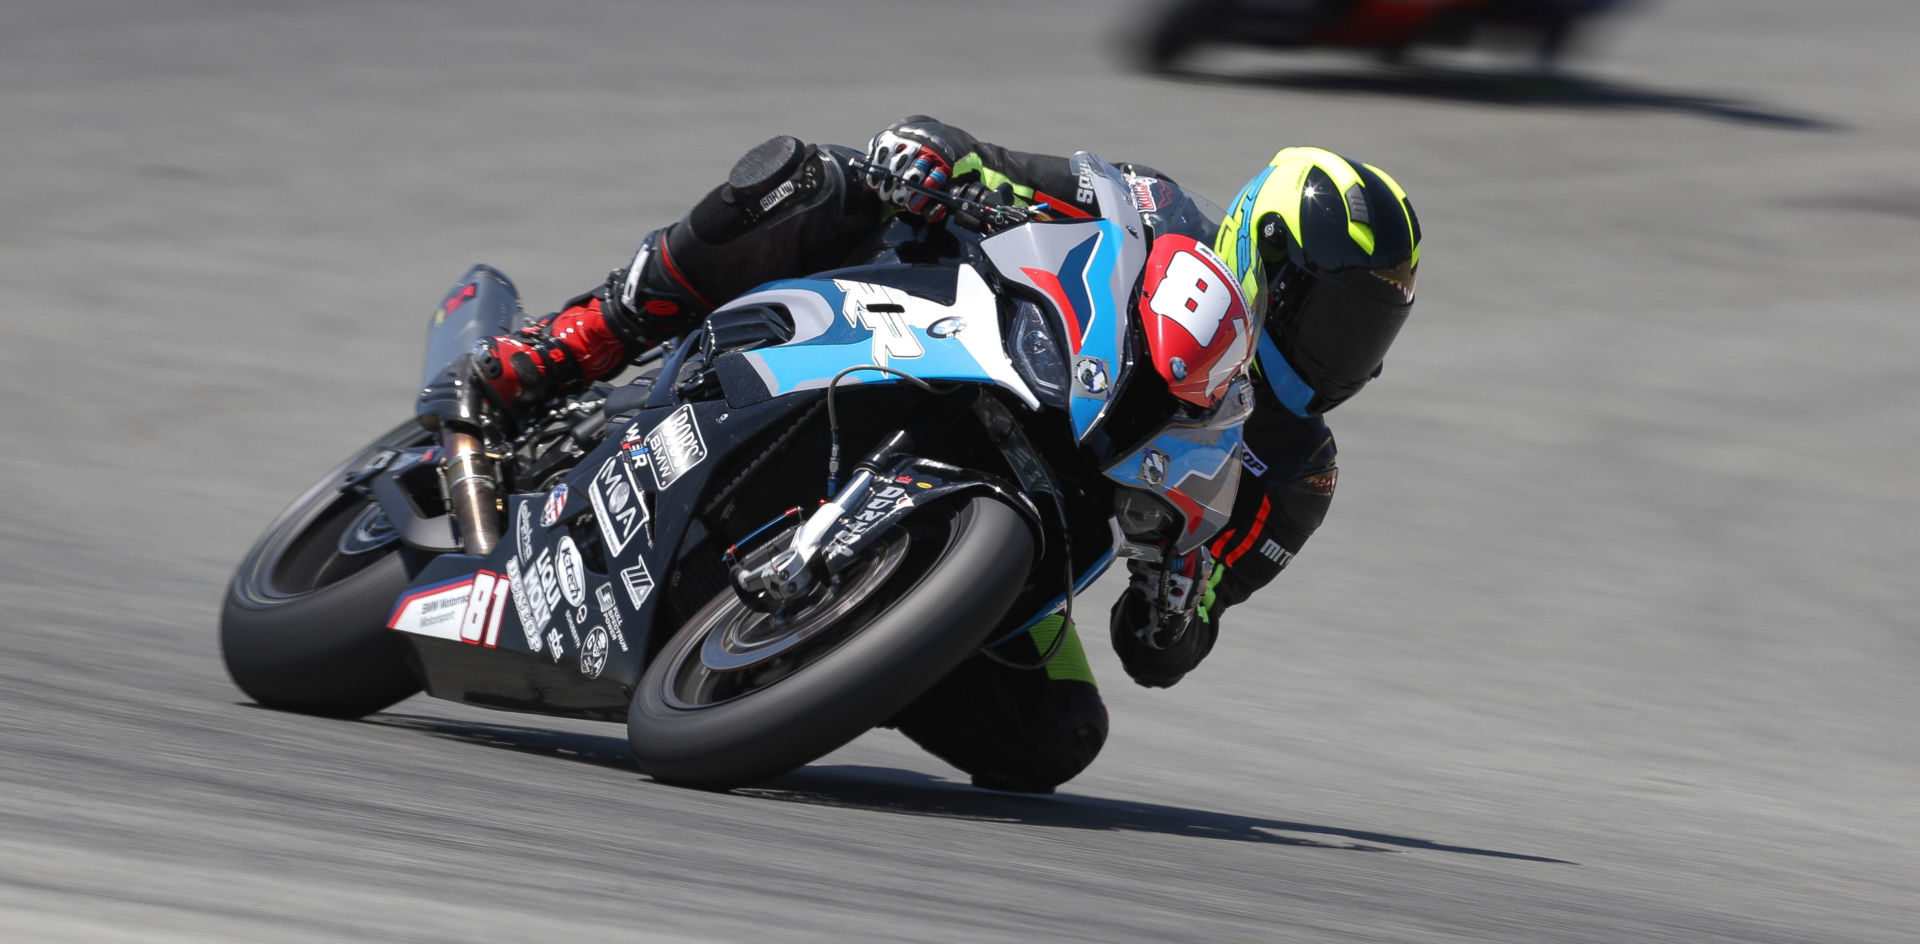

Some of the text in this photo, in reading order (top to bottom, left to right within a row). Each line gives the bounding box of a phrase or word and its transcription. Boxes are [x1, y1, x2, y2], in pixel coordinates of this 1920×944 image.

[760, 180, 794, 211] MITHOS
[1149, 250, 1249, 399] 81
[650, 434, 672, 478] BMW
[505, 554, 543, 653] DUNLOP
[523, 561, 552, 630] MOLY
[535, 546, 562, 612] LIQUI
[460, 568, 511, 650] 81
[602, 612, 618, 641] POWER
[607, 608, 629, 653] SPECTRUM
[612, 606, 624, 627] FULL
